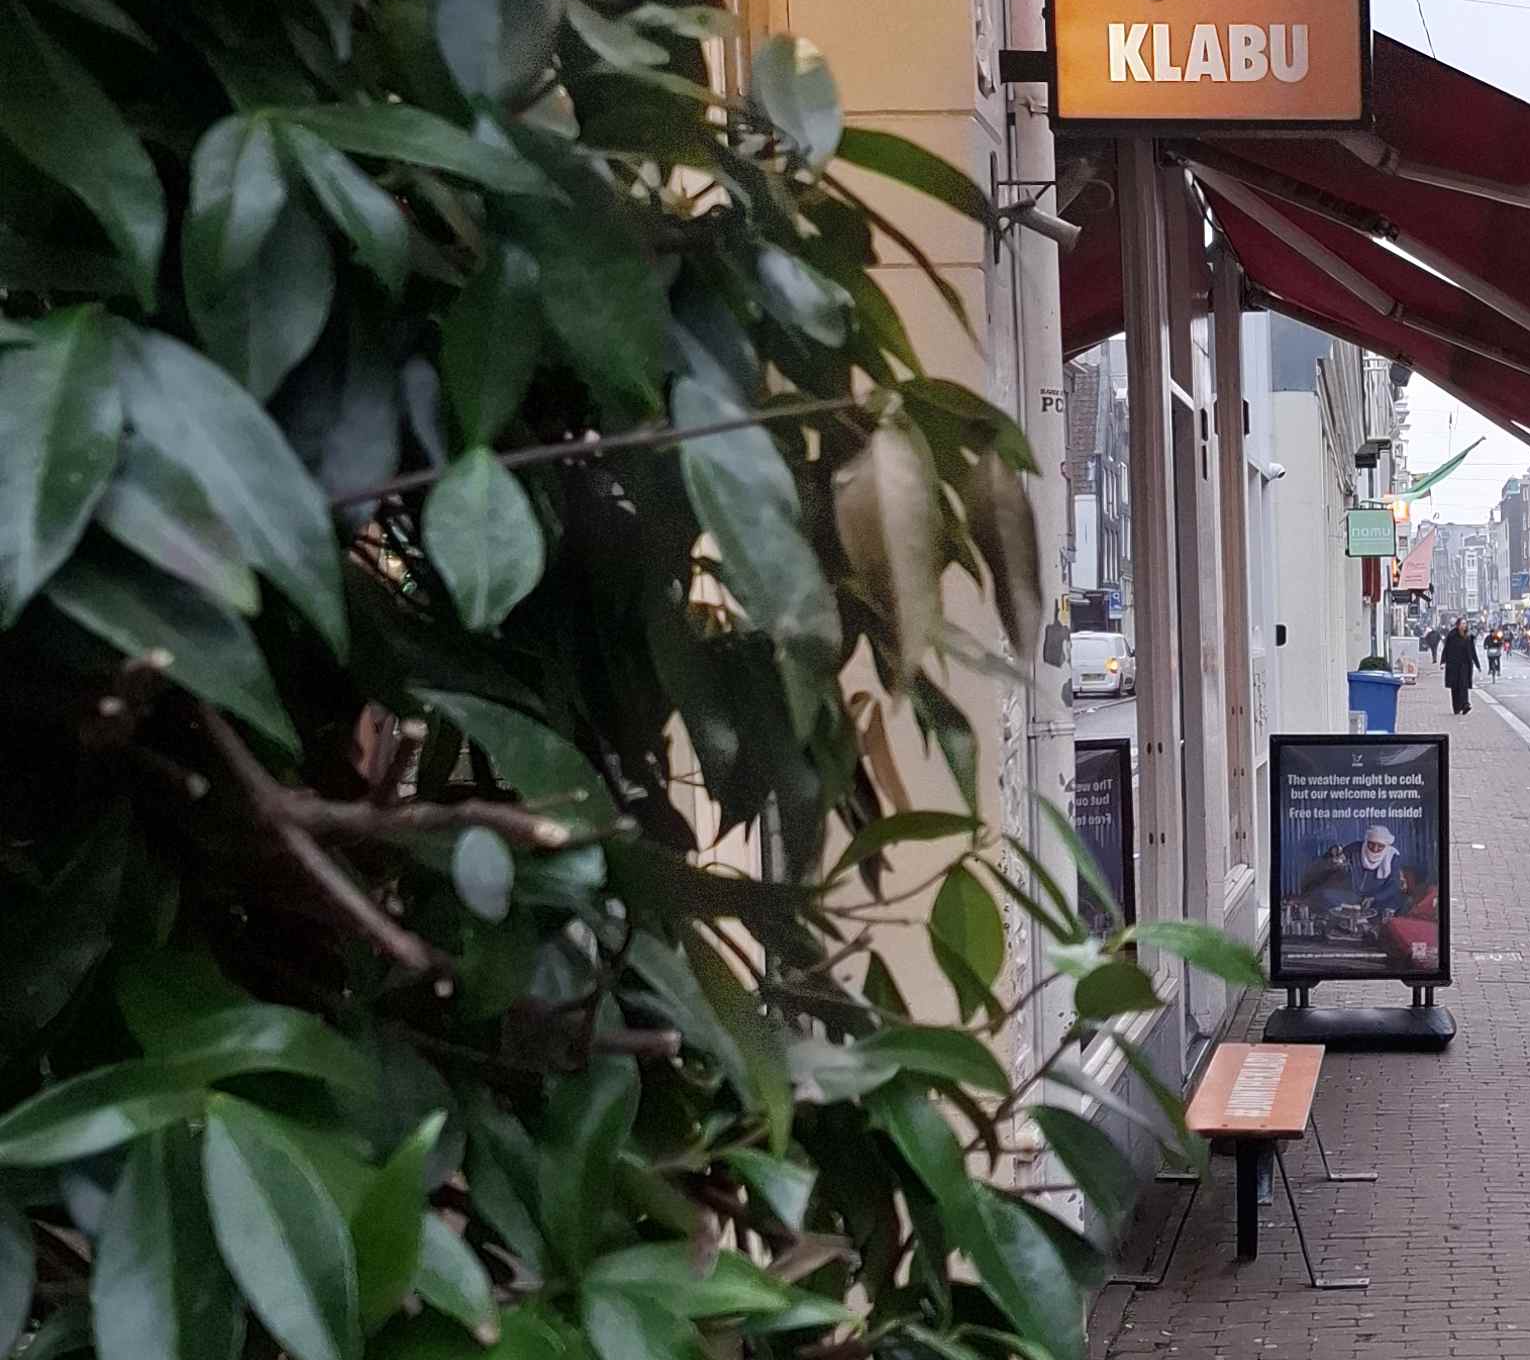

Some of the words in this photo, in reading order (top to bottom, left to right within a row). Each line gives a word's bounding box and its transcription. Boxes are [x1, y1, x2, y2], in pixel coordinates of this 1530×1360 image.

[1108, 23, 1309, 82] KLABU
[1288, 774, 1306, 785] The
[1308, 774, 1350, 785] weather
[1352, 774, 1382, 787] might
[1385, 774, 1398, 785] be
[1399, 774, 1425, 786] cold,
[1291, 789, 1308, 799] but
[1311, 790, 1328, 799] our
[1330, 788, 1376, 799] welcome
[1378, 788, 1387, 799] is
[1388, 790, 1421, 799] warm.
[1289, 807, 1311, 818] Free
[1313, 808, 1329, 818] tea
[1332, 807, 1350, 818] and
[1353, 807, 1386, 818] coffee
[1388, 807, 1422, 818] inside!
